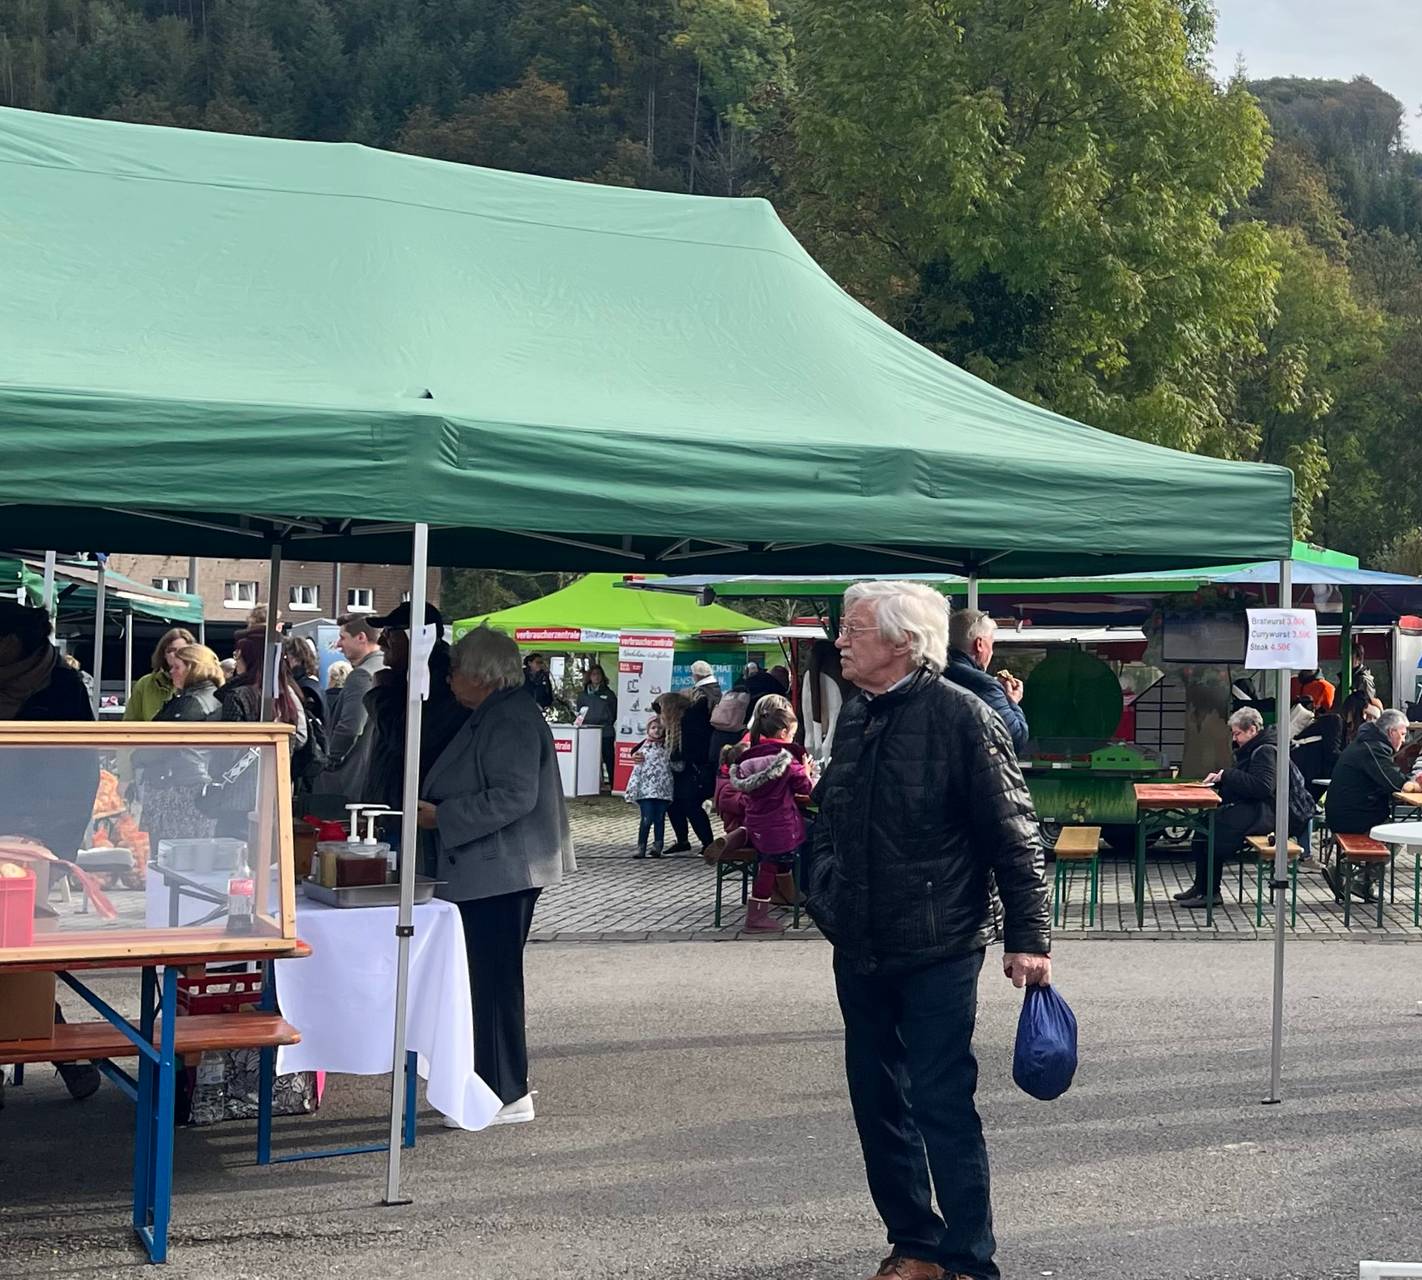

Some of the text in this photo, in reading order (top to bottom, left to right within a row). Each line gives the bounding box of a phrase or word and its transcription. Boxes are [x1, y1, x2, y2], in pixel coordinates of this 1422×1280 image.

[1251, 617, 1285, 625] Bratwurst
[516, 630, 580, 640] verbraucherzentrale
[1251, 631, 1290, 639] Currywurst
[620, 637, 674, 647] verbraucherzentrale
[1250, 642, 1268, 651] Steak
